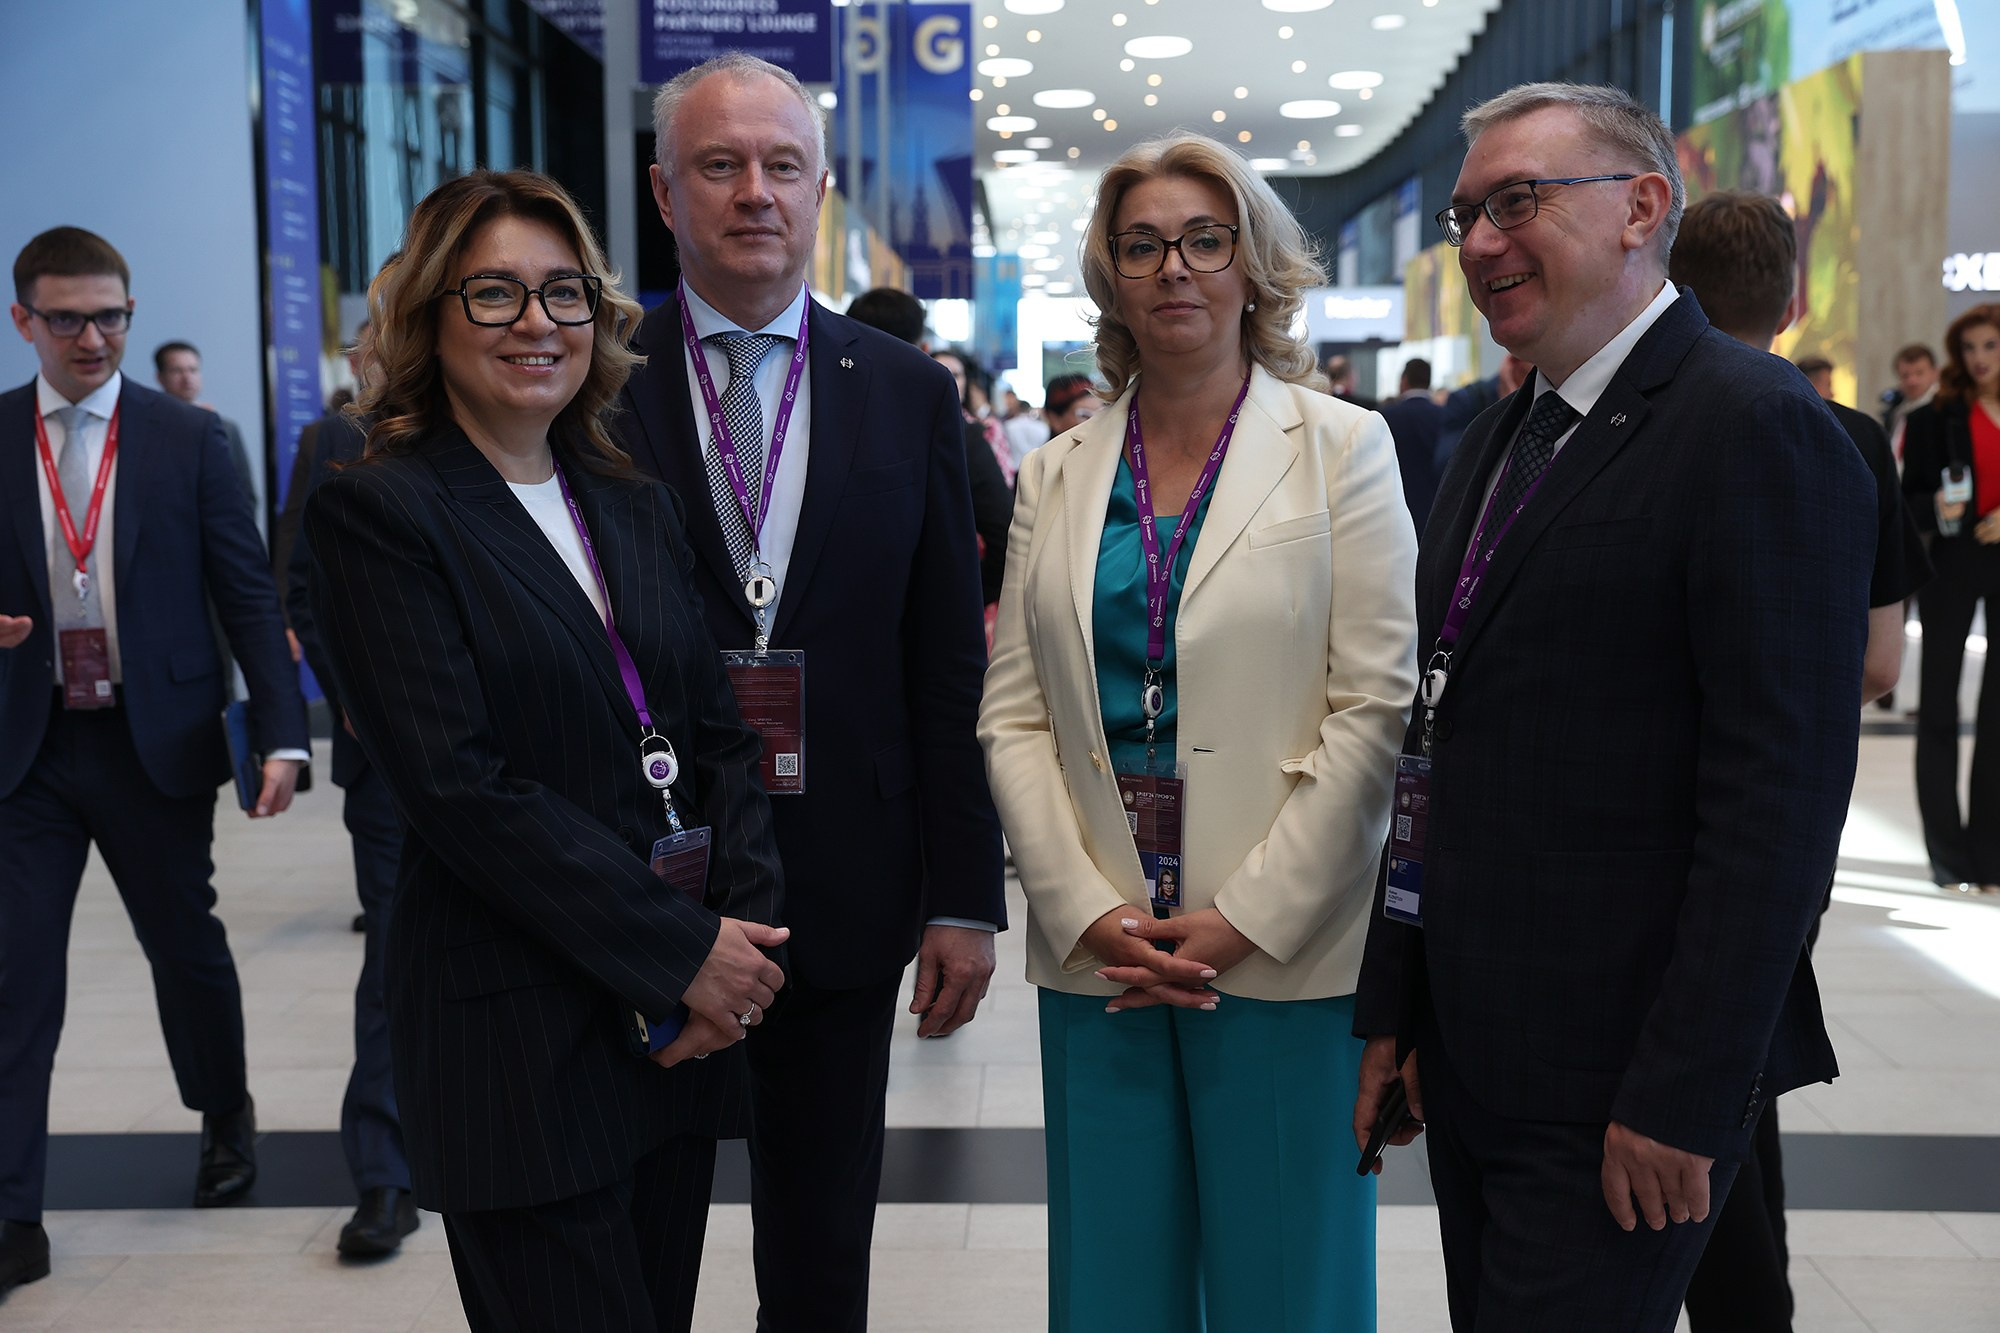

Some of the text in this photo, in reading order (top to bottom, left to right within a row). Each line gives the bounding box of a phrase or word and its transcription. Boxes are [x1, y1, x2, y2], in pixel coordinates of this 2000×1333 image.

[746, 13, 817, 33] LOUNGE
[914, 14, 964, 75] G
[1159, 856, 1178, 866] 2024
